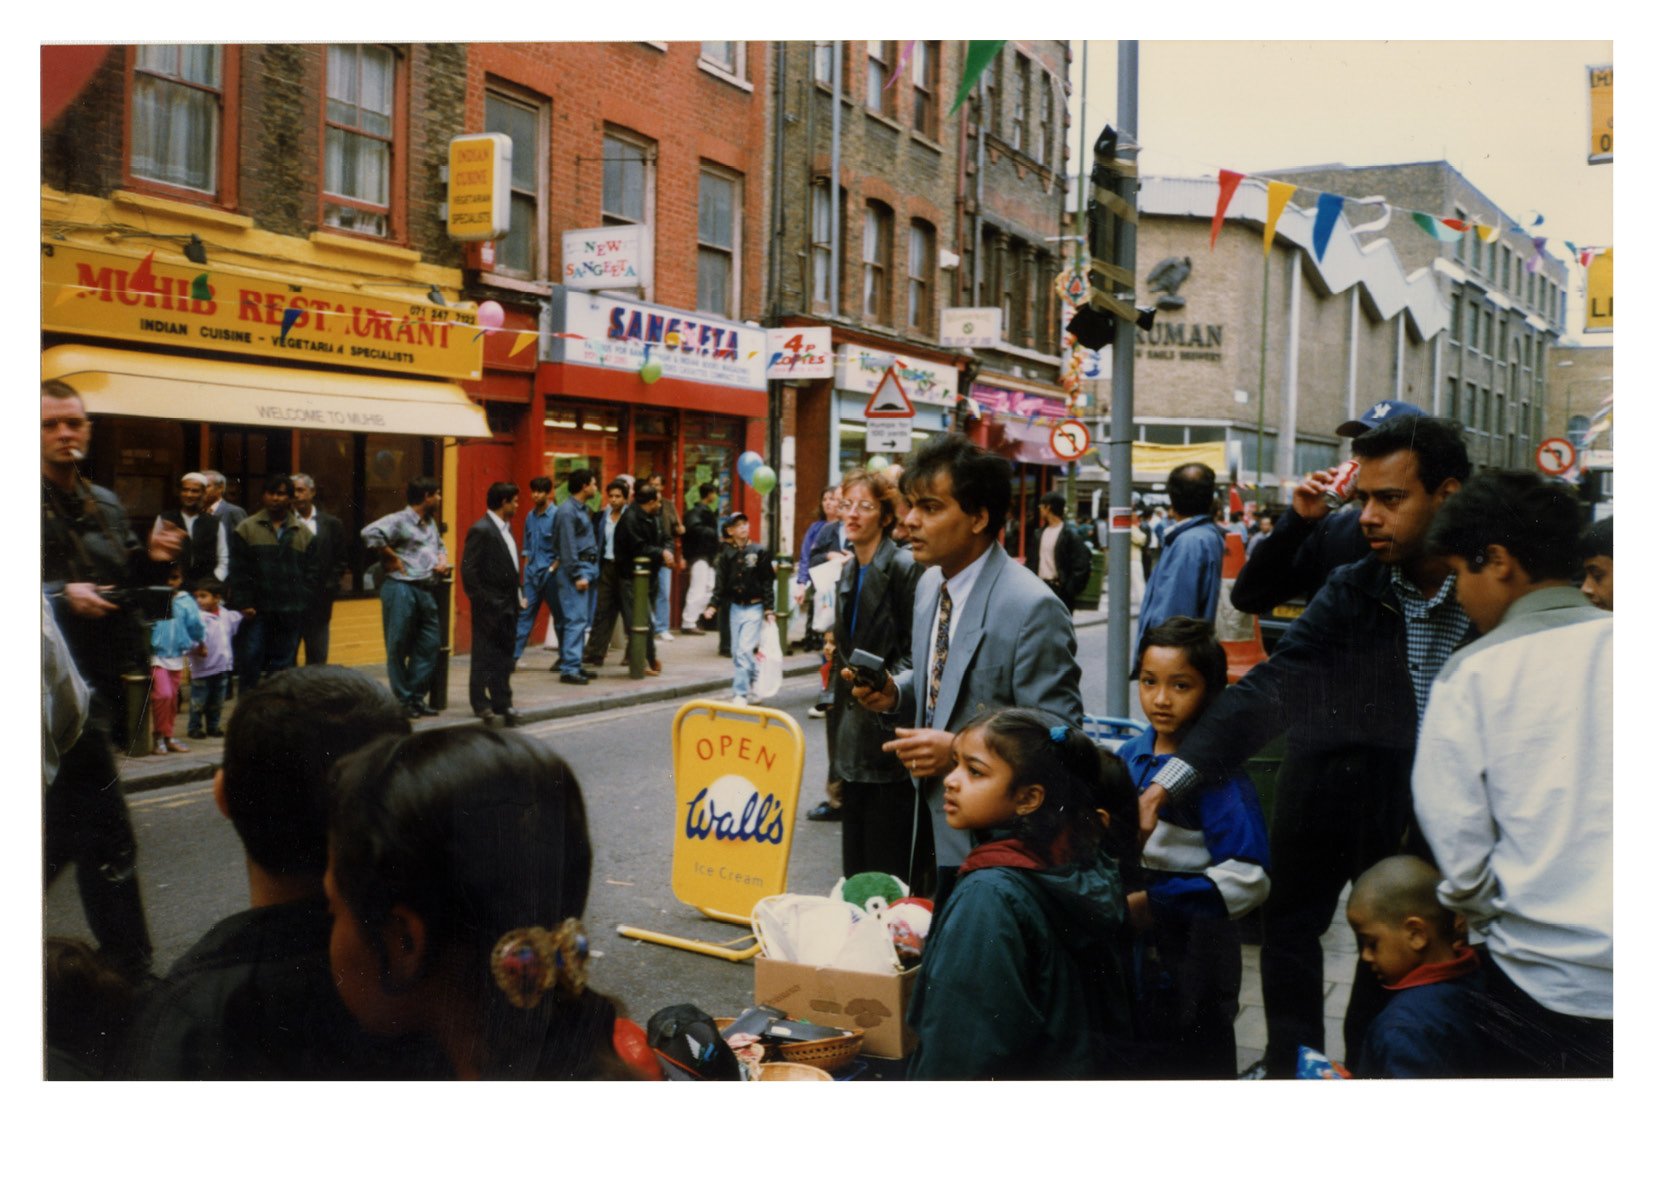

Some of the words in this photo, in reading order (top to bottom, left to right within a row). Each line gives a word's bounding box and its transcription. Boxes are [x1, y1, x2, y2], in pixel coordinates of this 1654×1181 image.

[584, 240, 624, 256] NEW
[566, 259, 637, 278] SANGEETA
[76, 262, 218, 317] MUHIB
[140, 318, 188, 335] INDIAN
[200, 326, 252, 344] CUISINE
[351, 344, 414, 364] SPECIALISTS
[772, 355, 825, 365] OIES
[256, 405, 325, 424] WELCOME
[327, 411, 345, 425] TO
[347, 412, 386, 427] MUHIB
[696, 735, 776, 771] OPEN
[685, 788, 784, 845] Wall's
[694, 862, 715, 877] Ice
[719, 866, 764, 888] Cream
